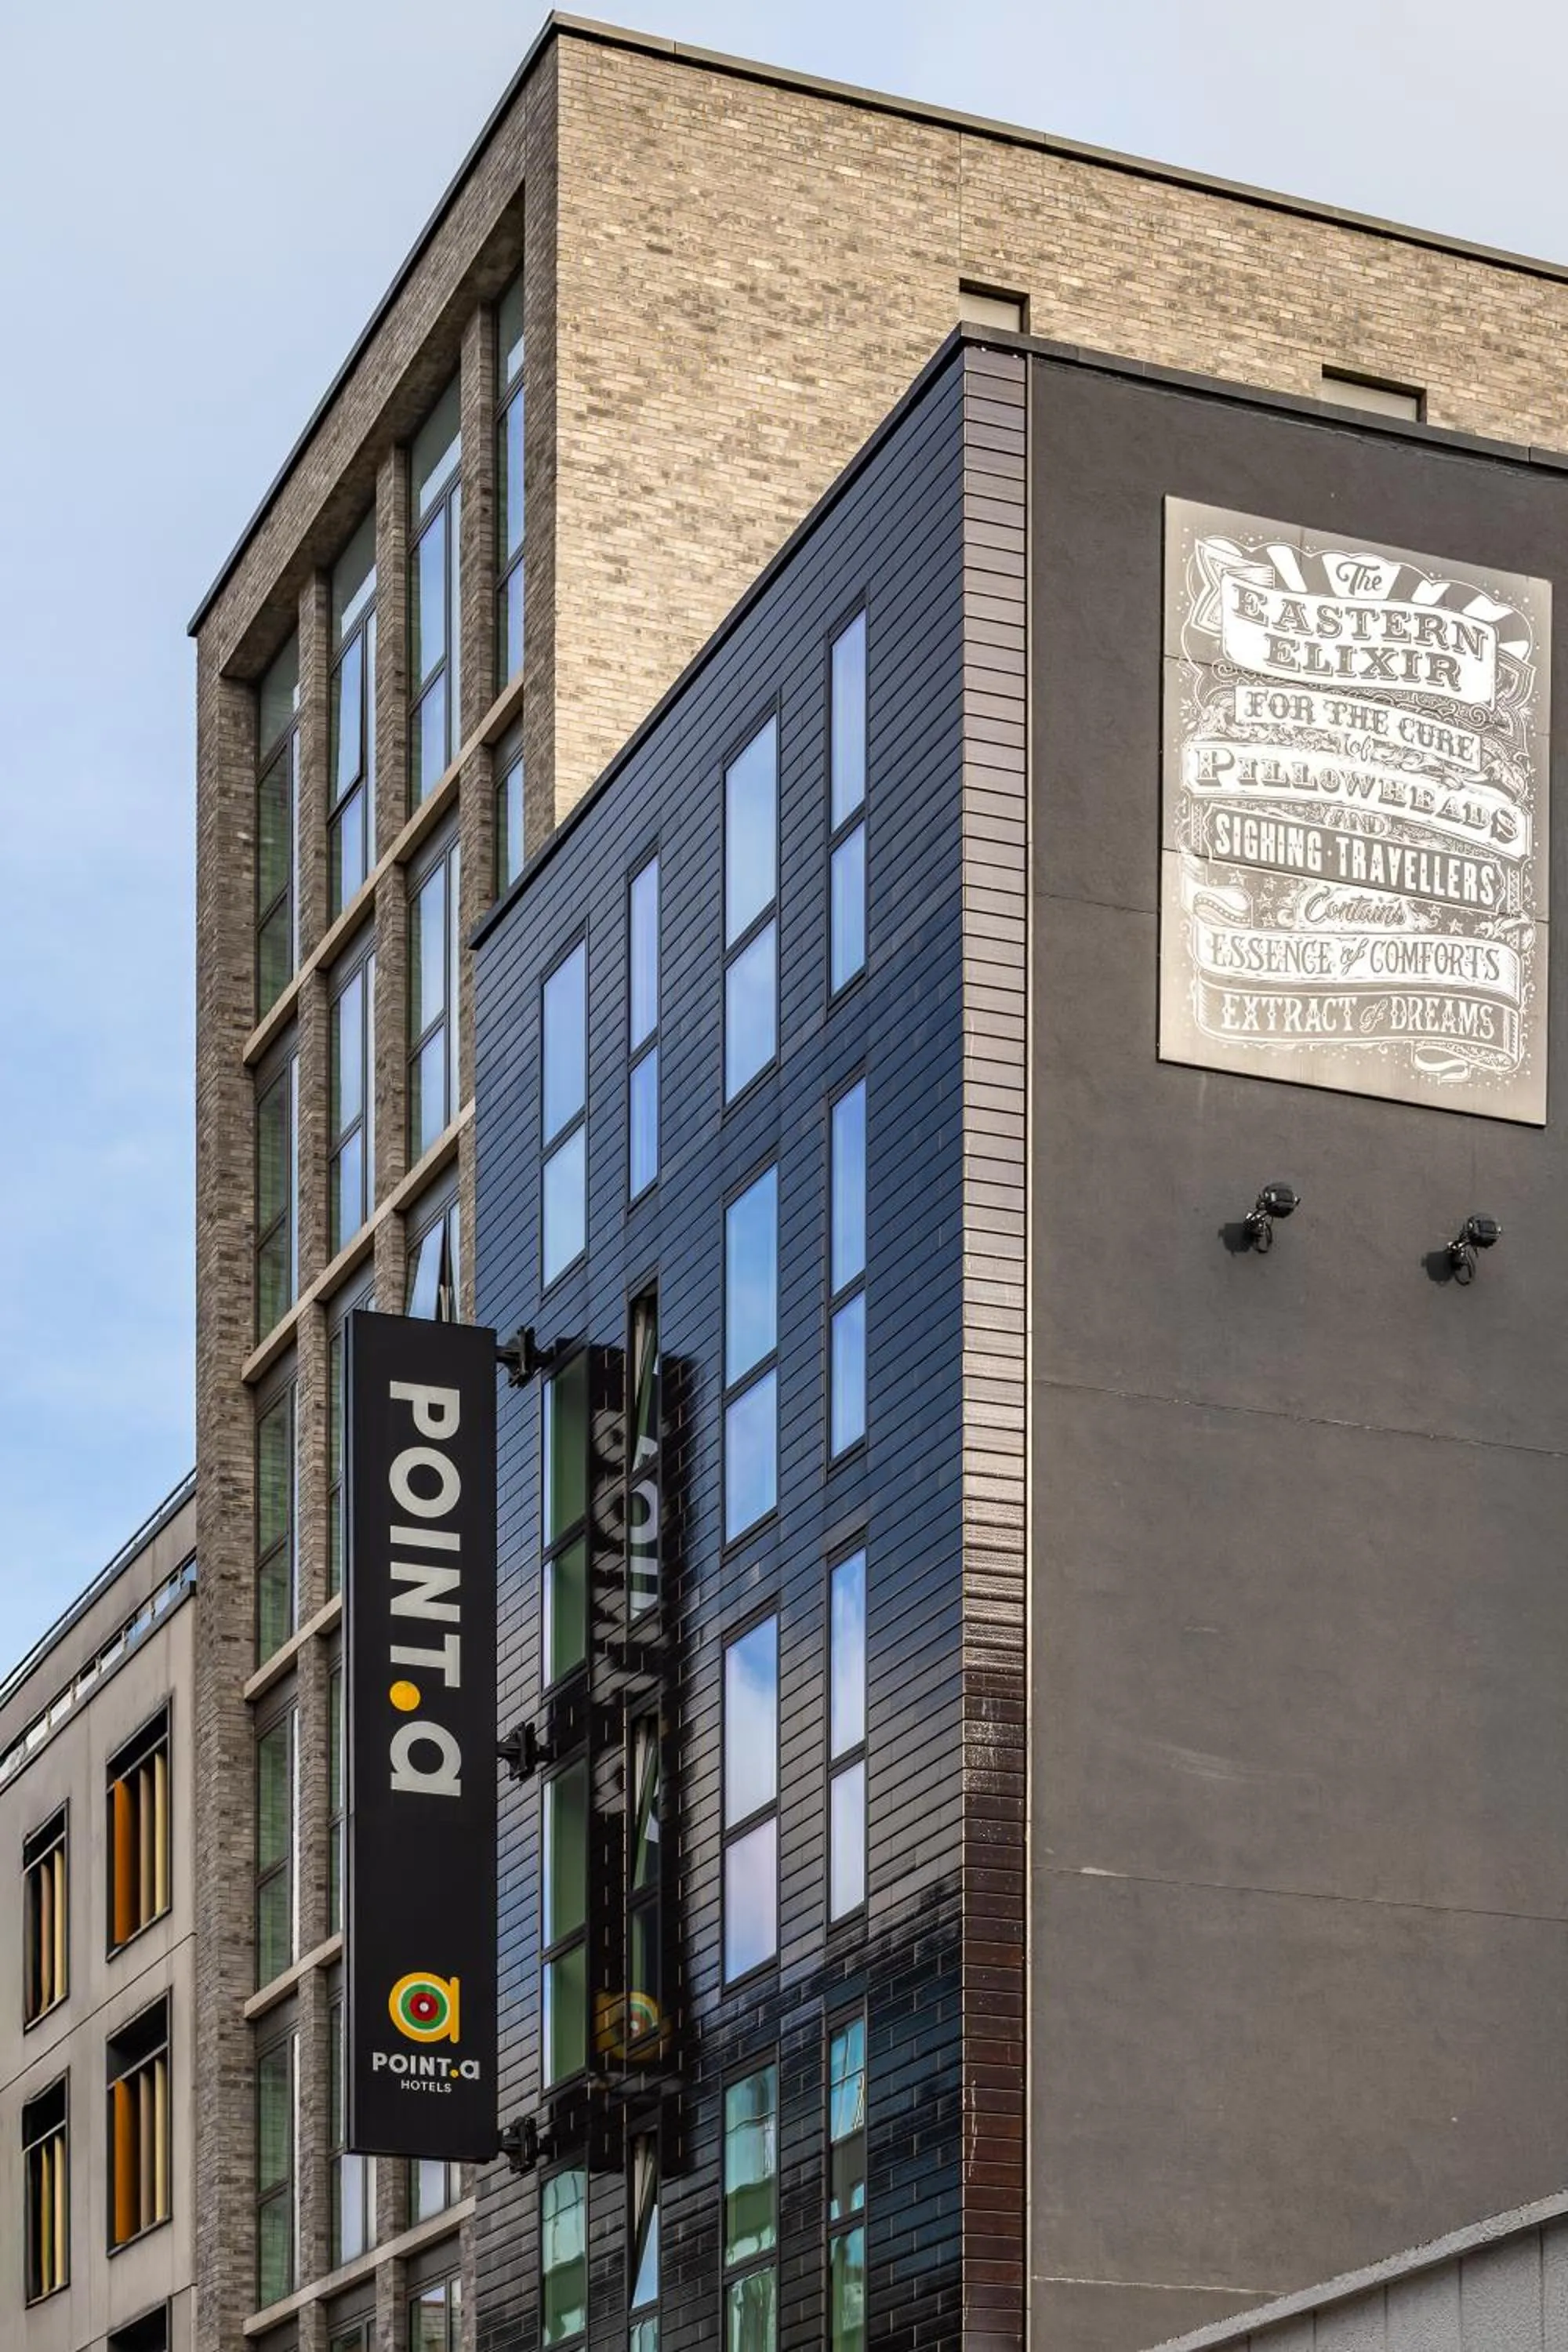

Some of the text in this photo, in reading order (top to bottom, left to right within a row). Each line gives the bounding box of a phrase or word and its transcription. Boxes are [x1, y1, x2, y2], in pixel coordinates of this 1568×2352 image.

[1334, 561, 1383, 595] The
[1232, 583, 1488, 661] EASTERN
[1265, 633, 1462, 692] ELIXIR
[1243, 688, 1476, 763] FOR THE CURE
[1349, 735, 1372, 762] of
[1194, 747, 1519, 844] PILLOWHEADS
[1327, 807, 1386, 837] AND
[1214, 812, 1495, 906] SIGHING TRAVELLERS
[1304, 886, 1409, 927] Contains
[1210, 933, 1501, 982] ESSENCE of COMFORTS
[1221, 993, 1495, 1040] EXTRACT of DREAMS
[401, 2079, 452, 2094] HOTELS
